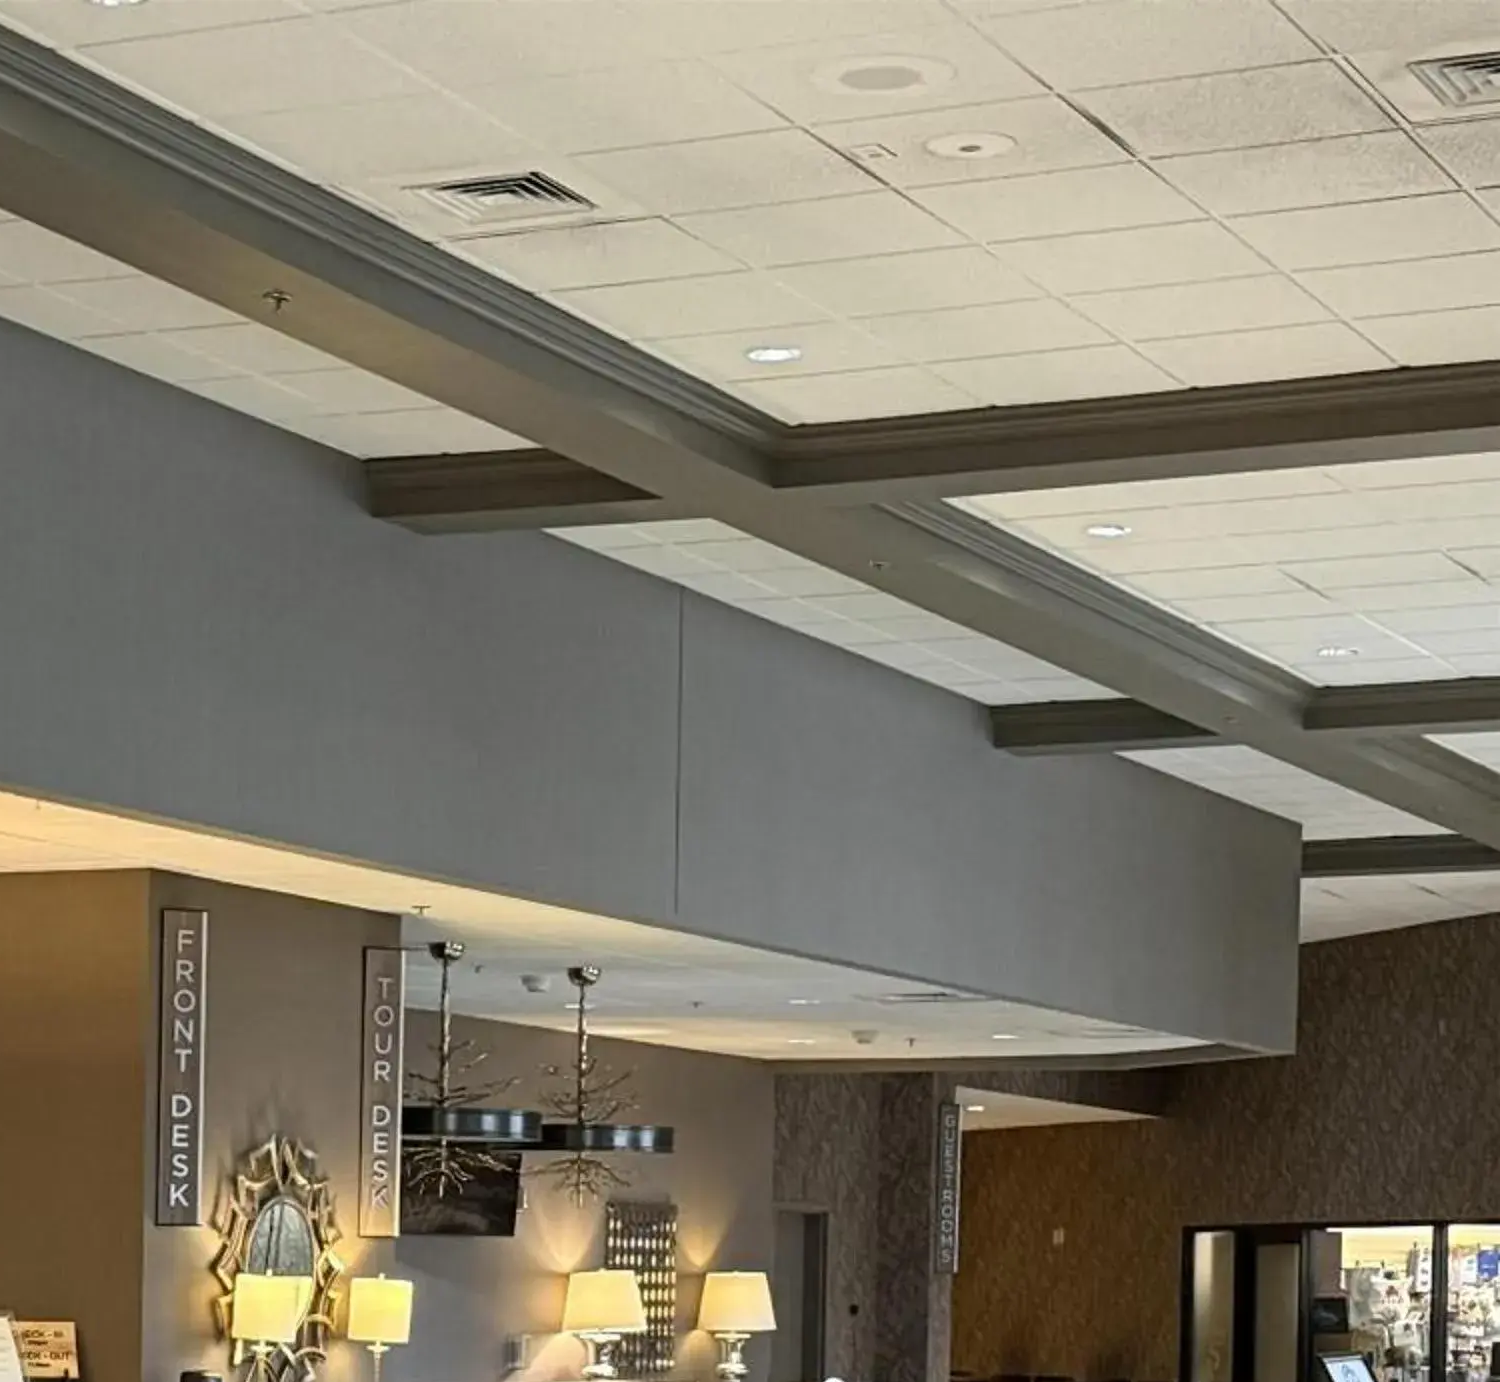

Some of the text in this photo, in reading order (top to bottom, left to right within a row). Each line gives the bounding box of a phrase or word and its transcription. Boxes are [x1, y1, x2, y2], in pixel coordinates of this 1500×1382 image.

[169, 930, 195, 1208] FRONT DESK
[371, 977, 395, 1209] TOUR DESK
[940, 1115, 956, 1263] GUESTROOMS
